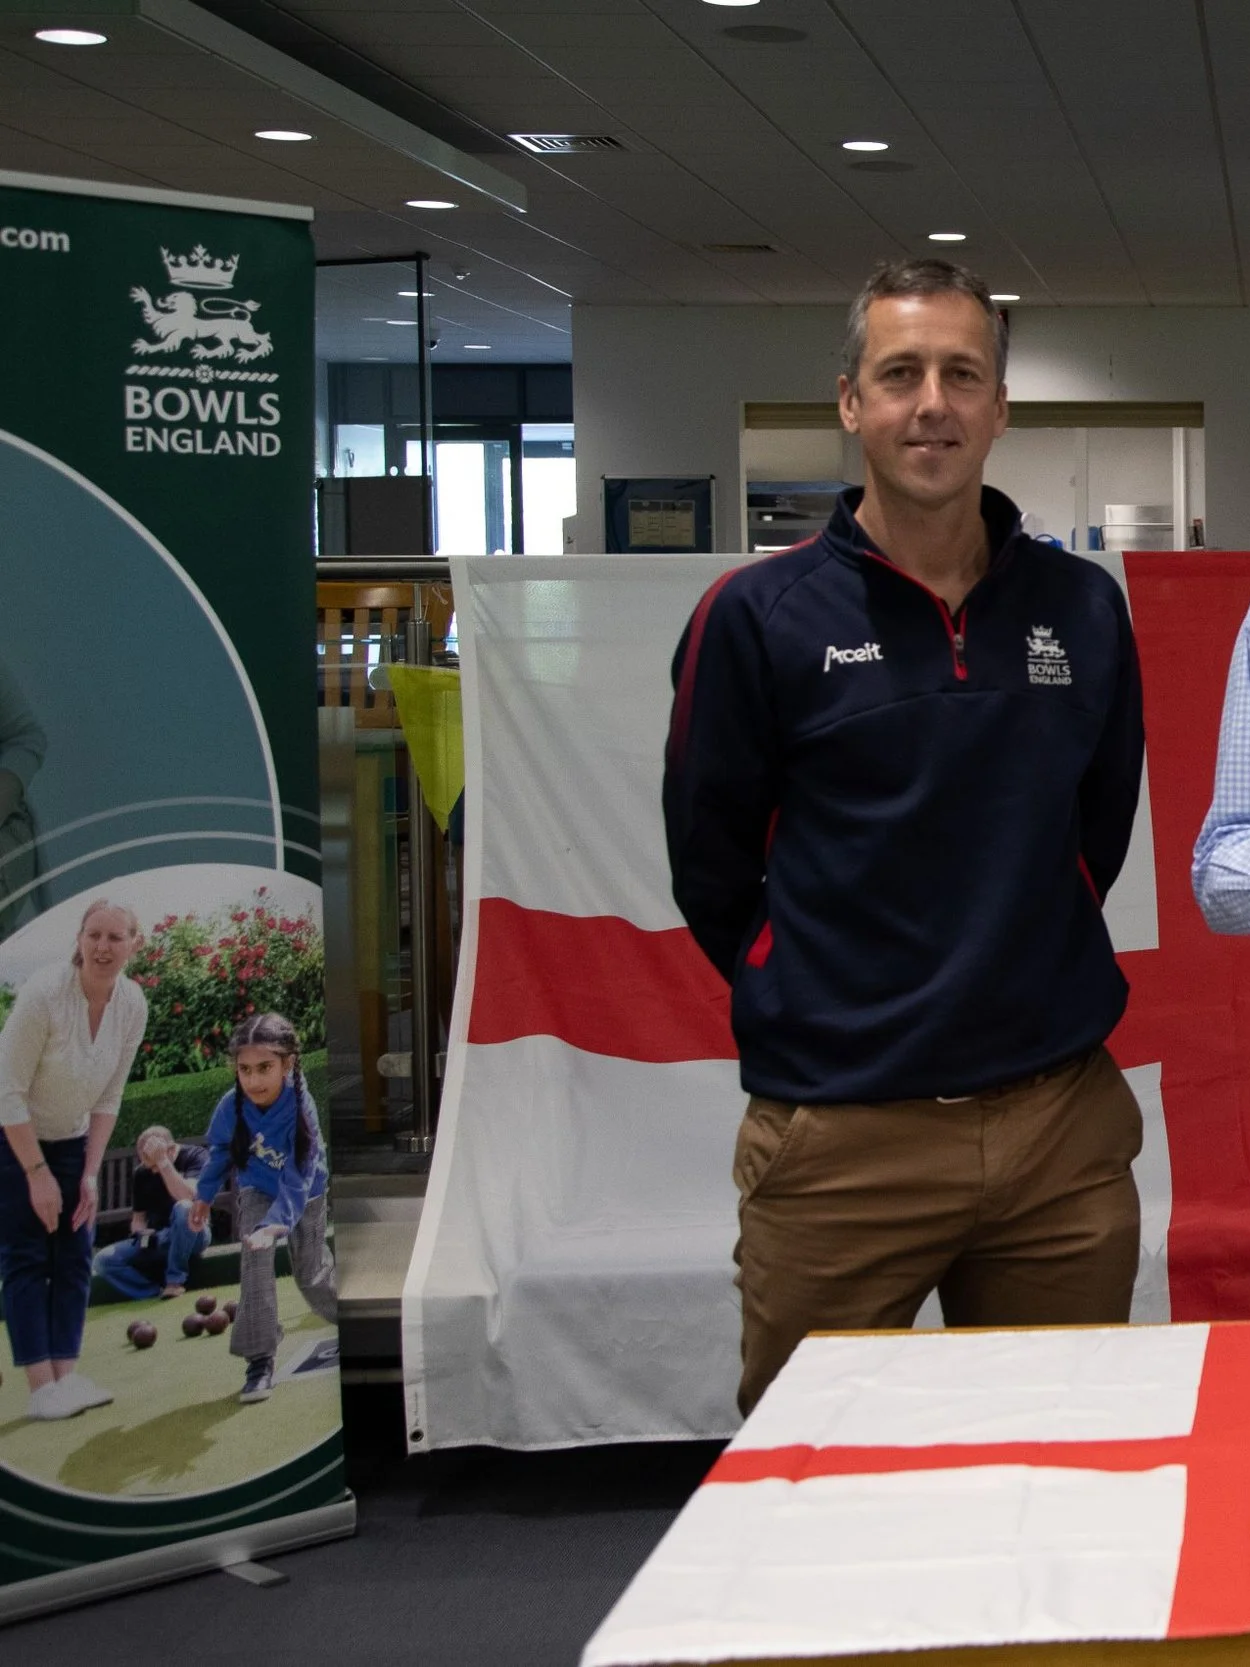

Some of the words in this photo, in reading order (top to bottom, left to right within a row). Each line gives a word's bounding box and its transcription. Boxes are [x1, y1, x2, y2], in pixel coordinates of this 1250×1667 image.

[125, 385, 281, 426] BOWLS
[126, 426, 282, 456] ENGLAND
[1027, 663, 1071, 676] BOWLS
[1029, 675, 1072, 685] ENGLAND
